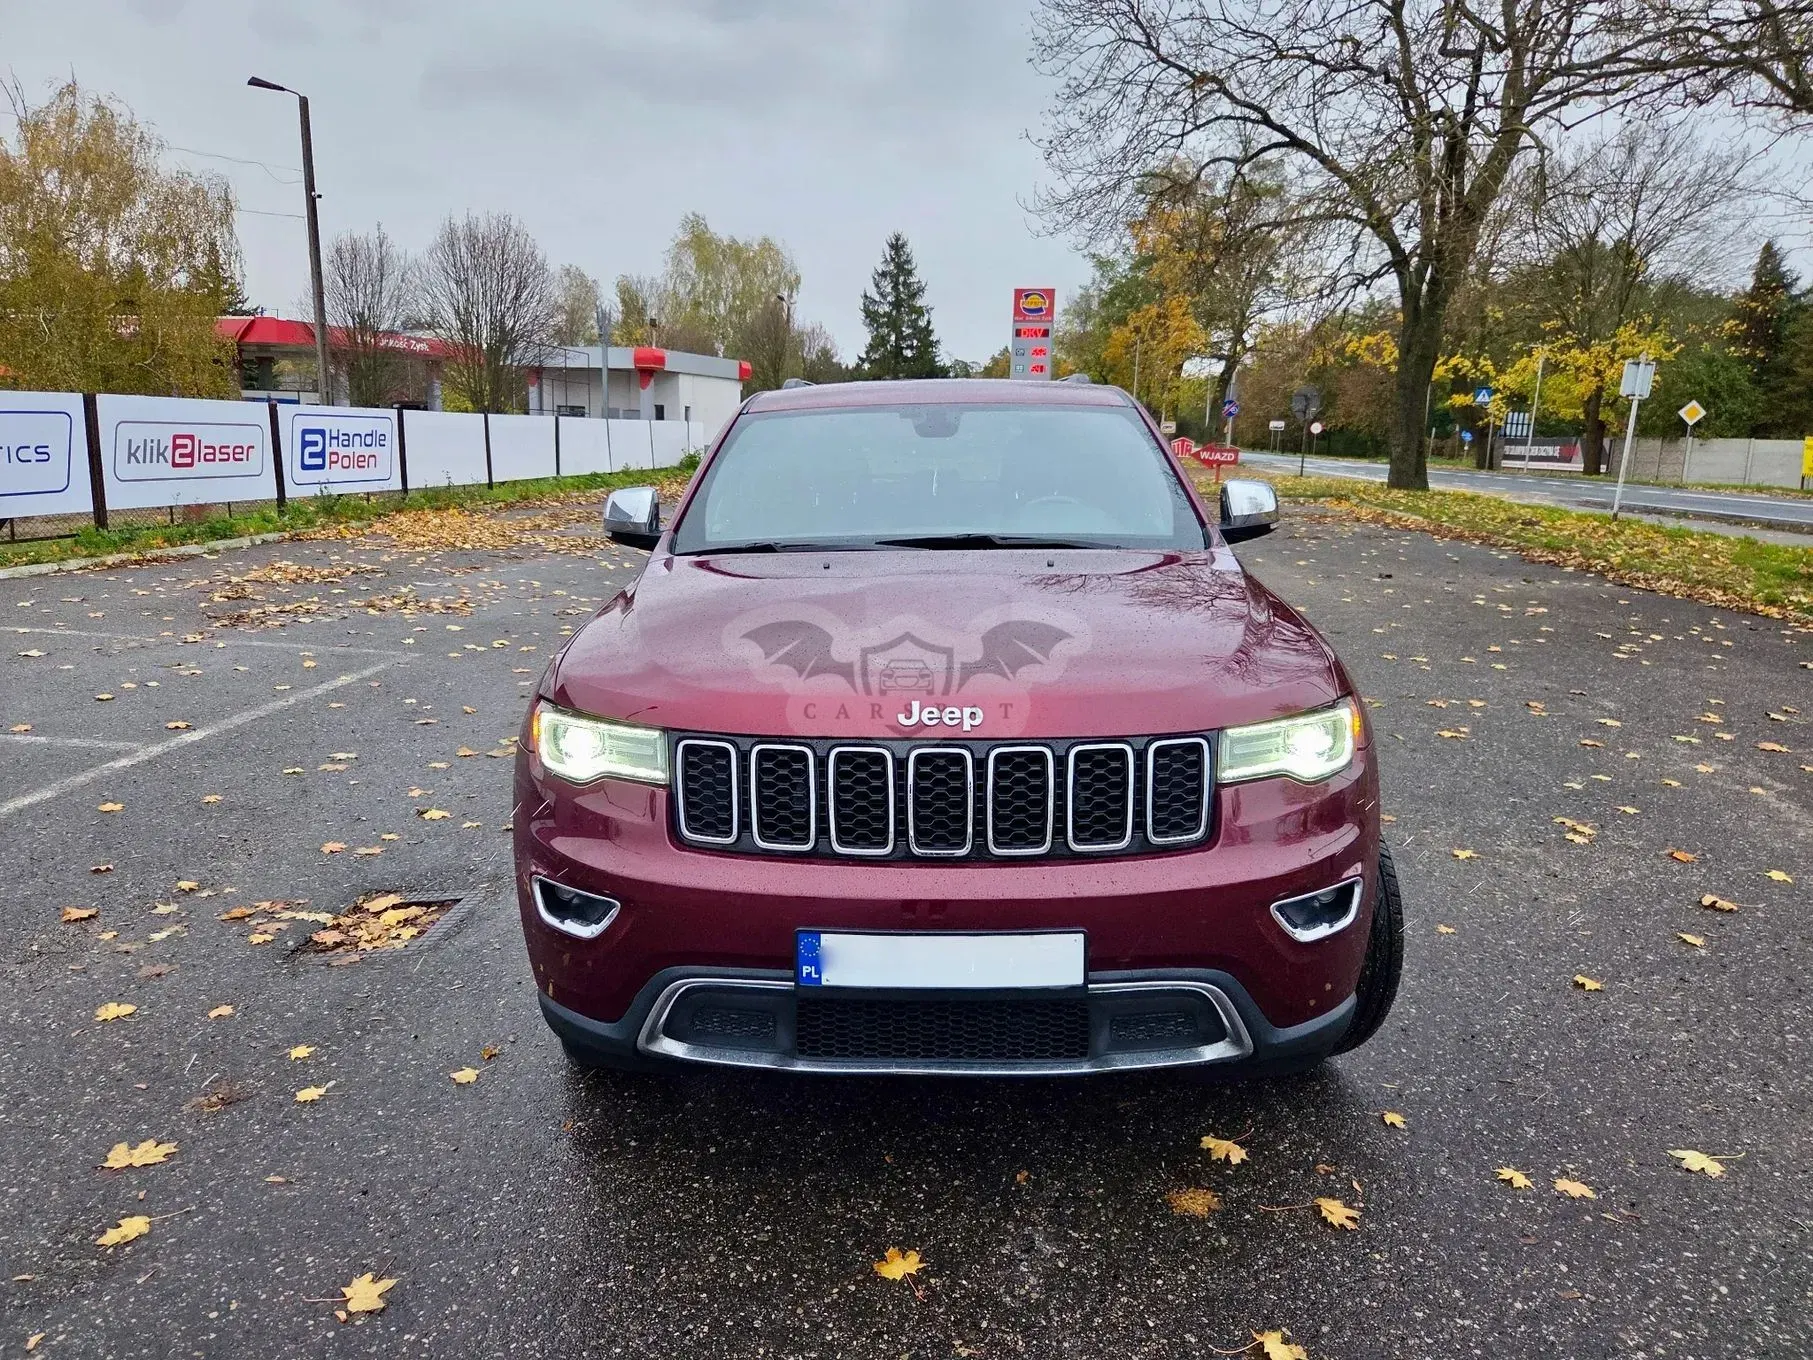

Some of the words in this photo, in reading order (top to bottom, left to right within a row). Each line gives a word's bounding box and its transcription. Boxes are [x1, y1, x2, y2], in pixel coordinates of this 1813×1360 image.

[1020, 328, 1044, 338] DKV
[329, 428, 387, 448] Handle
[0, 445, 51, 464] ICS
[127, 436, 255, 466] klik2laser
[329, 451, 377, 470] Polen
[1200, 451, 1235, 461] WJAZD
[897, 700, 984, 732] Jeep
[802, 965, 820, 978] PL
